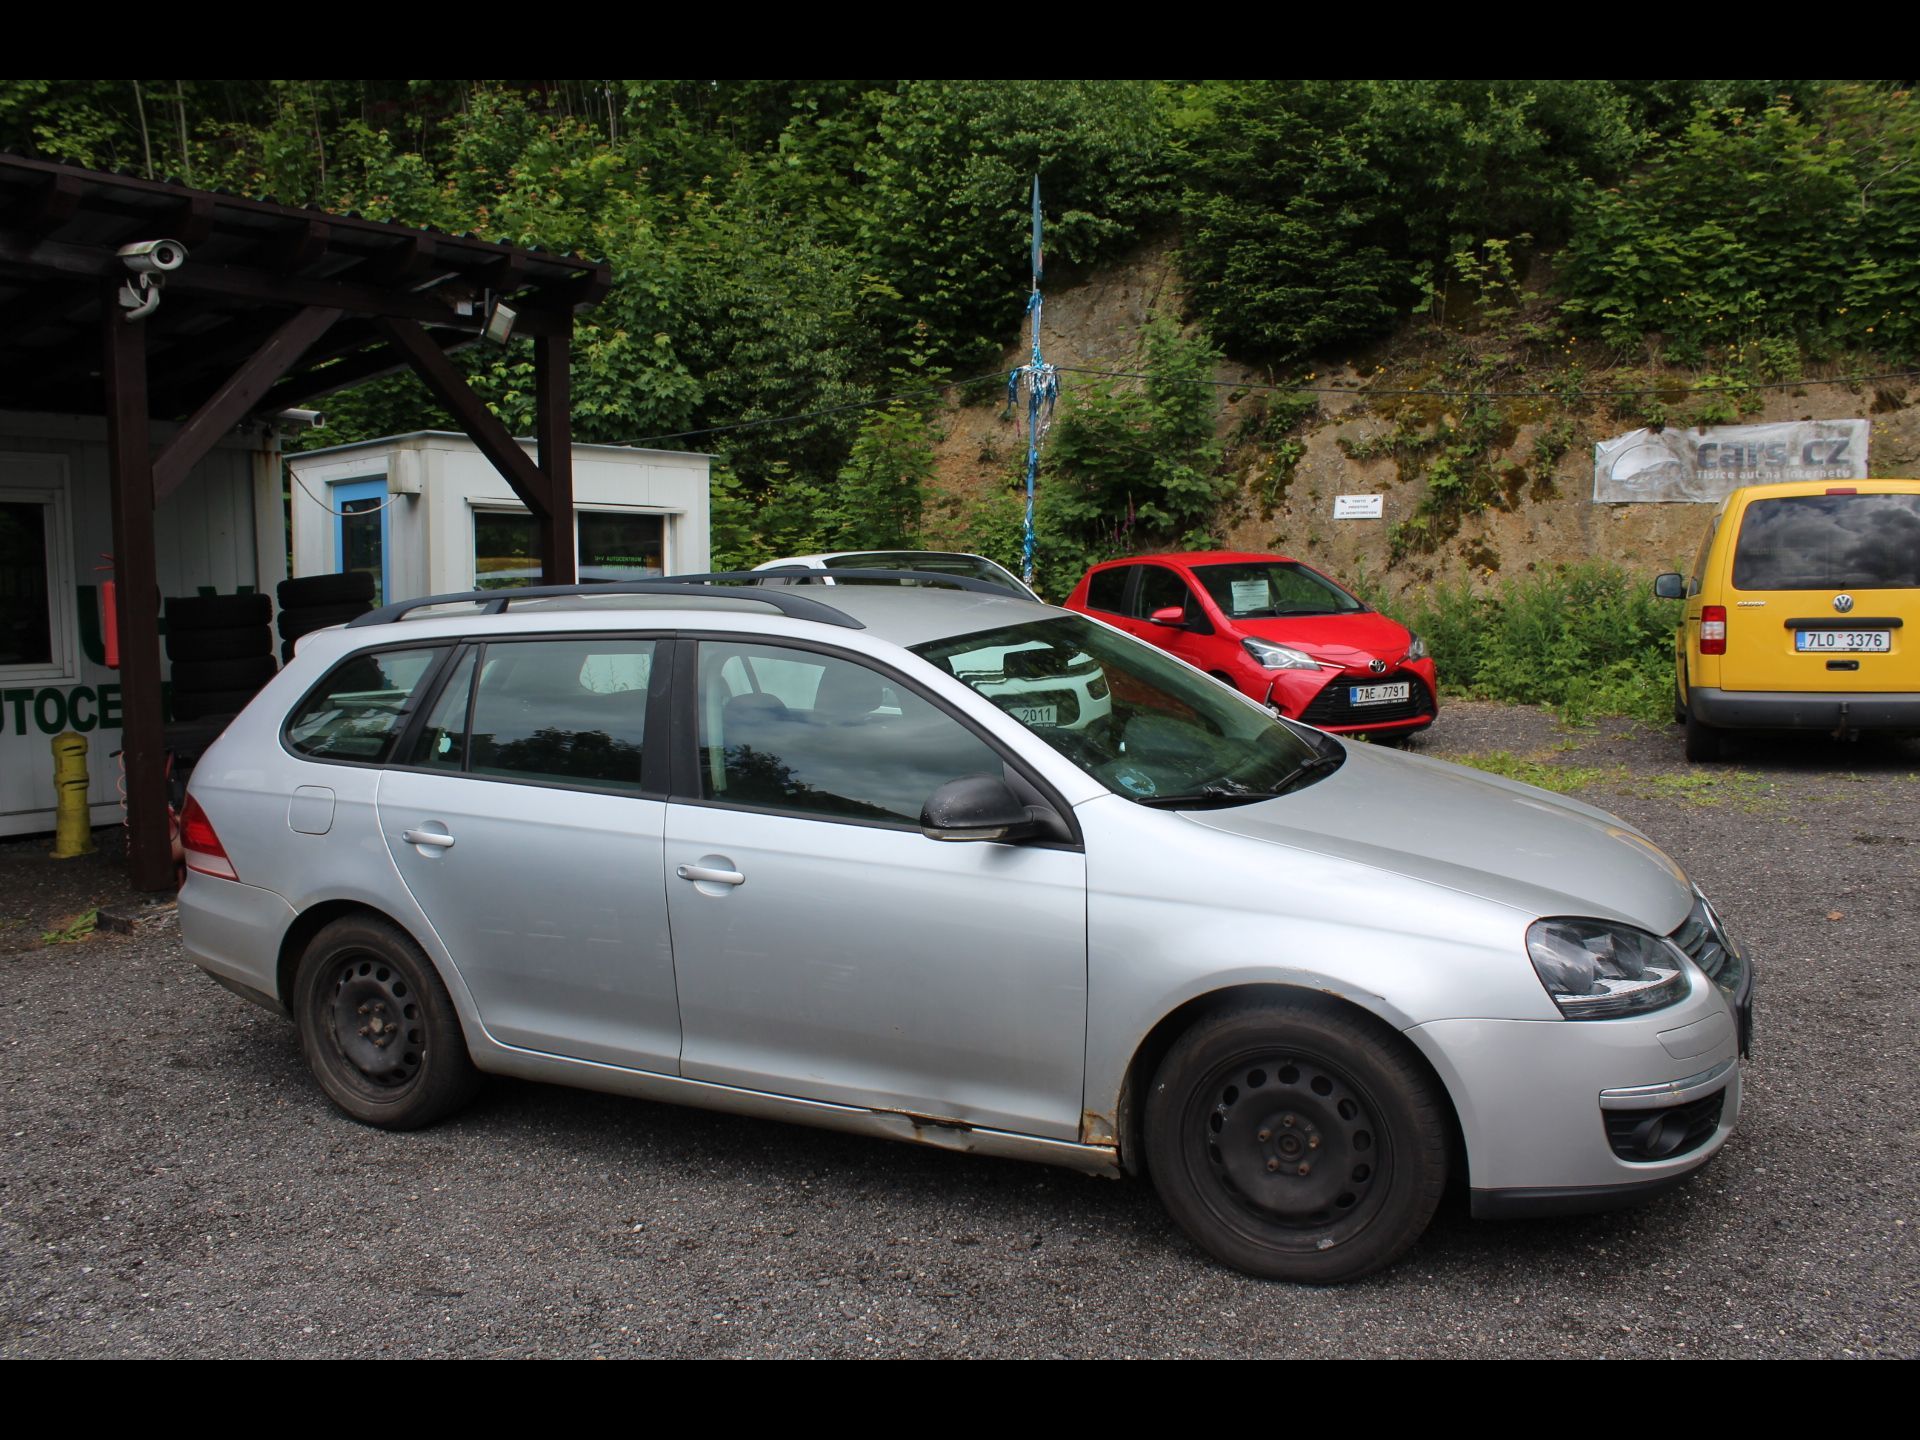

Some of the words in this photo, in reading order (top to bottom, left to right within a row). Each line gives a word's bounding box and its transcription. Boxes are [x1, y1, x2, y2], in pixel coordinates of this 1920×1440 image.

[1697, 438, 1850, 468] cars.cz
[1739, 470, 1760, 479] aut
[1765, 470, 1781, 479] na
[1785, 468, 1850, 479] internetu
[1808, 633, 1835, 647] 7L0
[1846, 633, 1883, 647] 3376
[1359, 687, 1376, 700] 7AE
[1382, 685, 1405, 699] 7791
[1022, 708, 1051, 723] 2011
